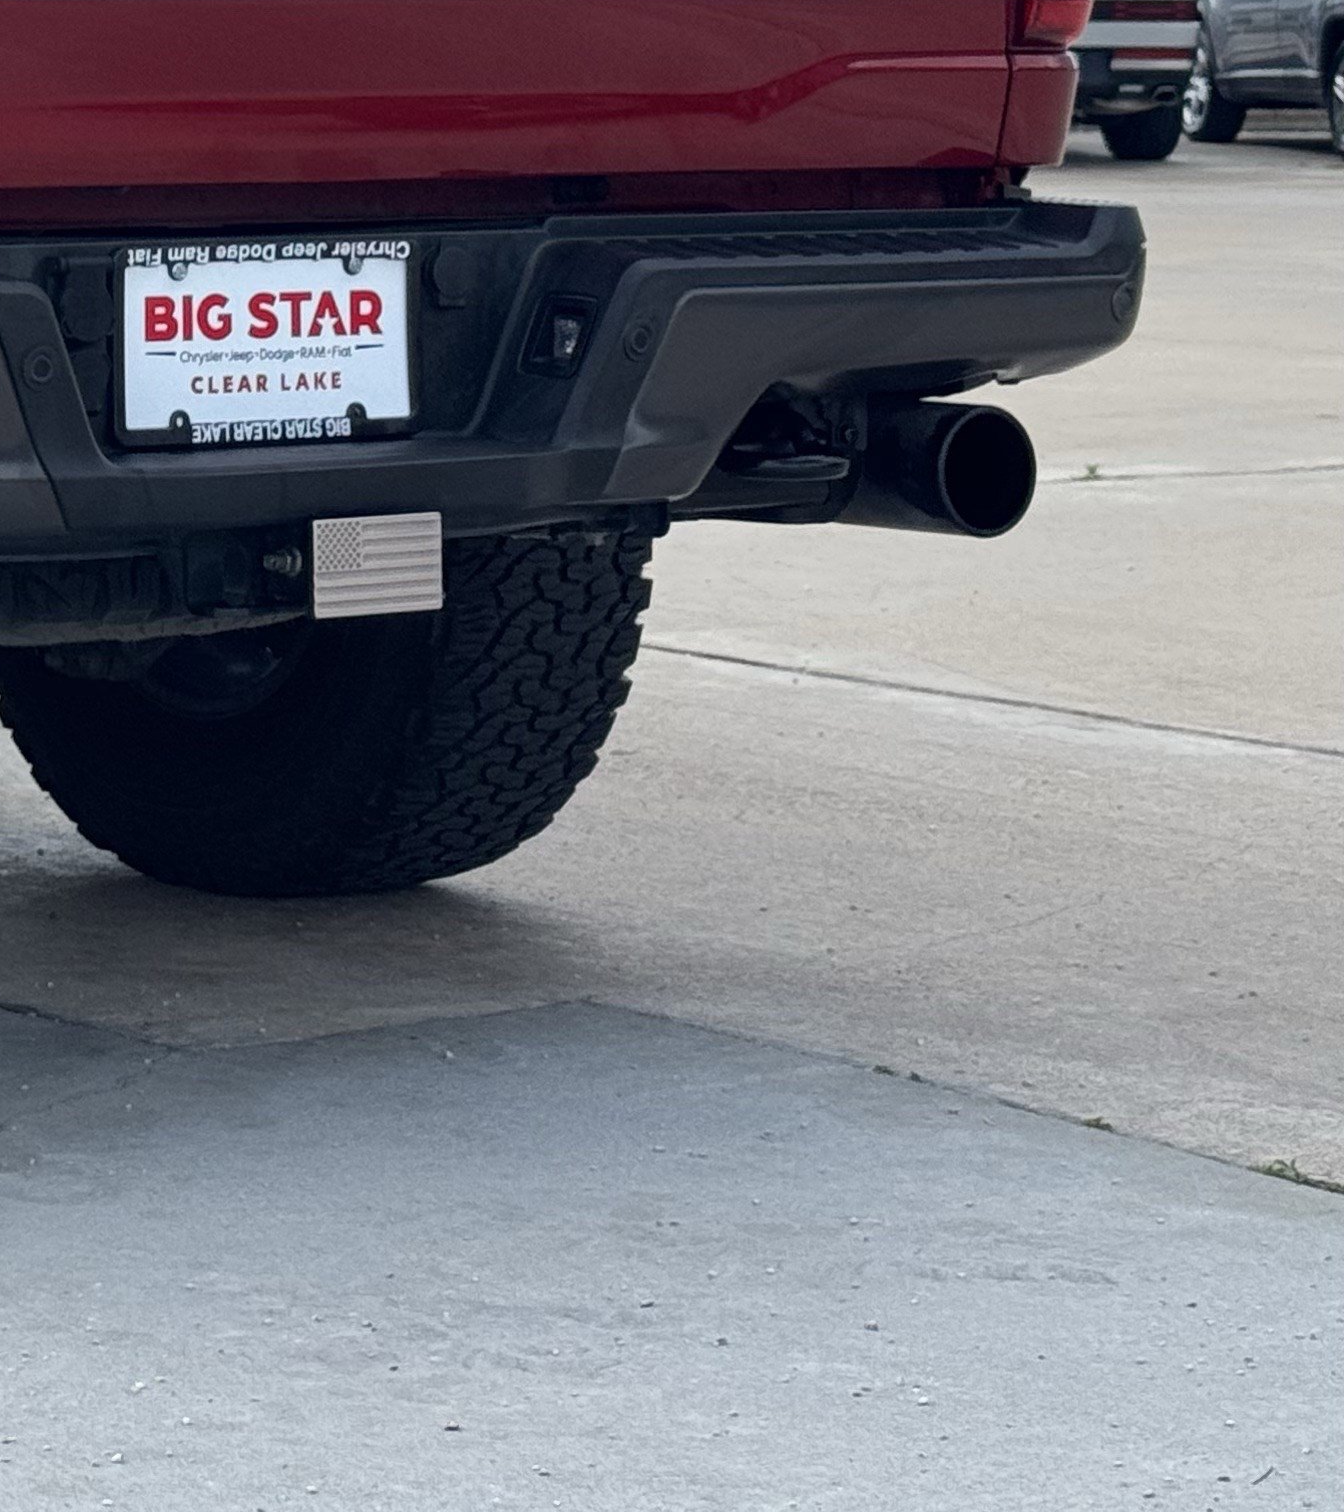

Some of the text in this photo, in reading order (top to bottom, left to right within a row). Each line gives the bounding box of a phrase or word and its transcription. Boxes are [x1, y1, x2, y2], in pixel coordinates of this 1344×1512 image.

[127, 240, 411, 266] Chrysler Jeep Dodge Ram Fiat
[144, 290, 383, 342] BIG STAR
[190, 371, 342, 395] CLEAR LAKE
[191, 417, 352, 444] BIG STAR CLEAR LAKE
